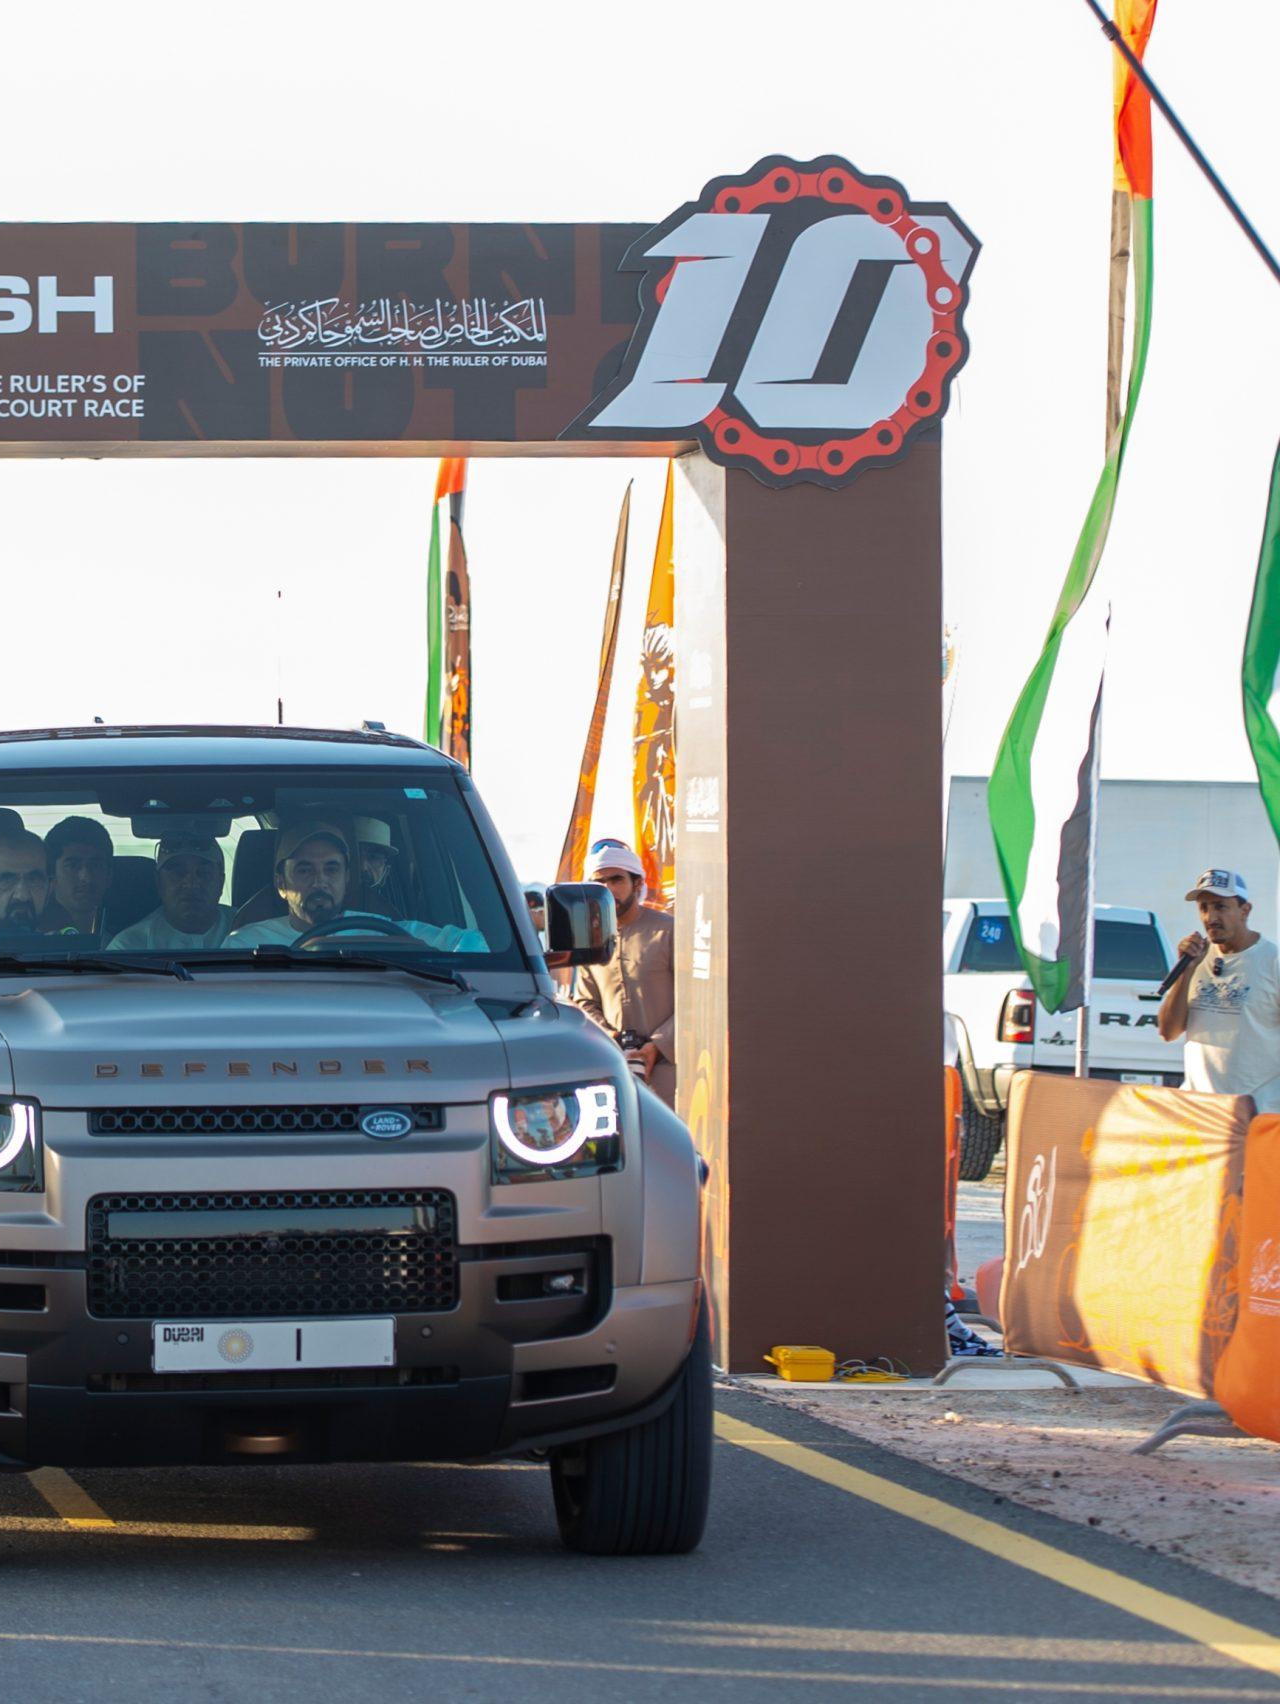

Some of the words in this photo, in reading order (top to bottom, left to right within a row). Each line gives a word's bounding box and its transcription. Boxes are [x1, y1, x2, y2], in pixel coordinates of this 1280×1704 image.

[588, 213, 973, 430] 10
[258, 356, 281, 367] THE
[284, 356, 331, 367] PRIVATE
[334, 356, 377, 367] OFFICE
[380, 356, 397, 367] OF
[399, 356, 411, 367] H.
[413, 356, 425, 367] H.
[427, 356, 450, 367] THE
[452, 356, 489, 367] RULER
[491, 355, 509, 367] OF
[511, 355, 547, 366] DUBAI
[112, 374, 146, 393] OF
[84, 399, 145, 418] RACE
[94, 1058, 433, 1079] DEFENDER
